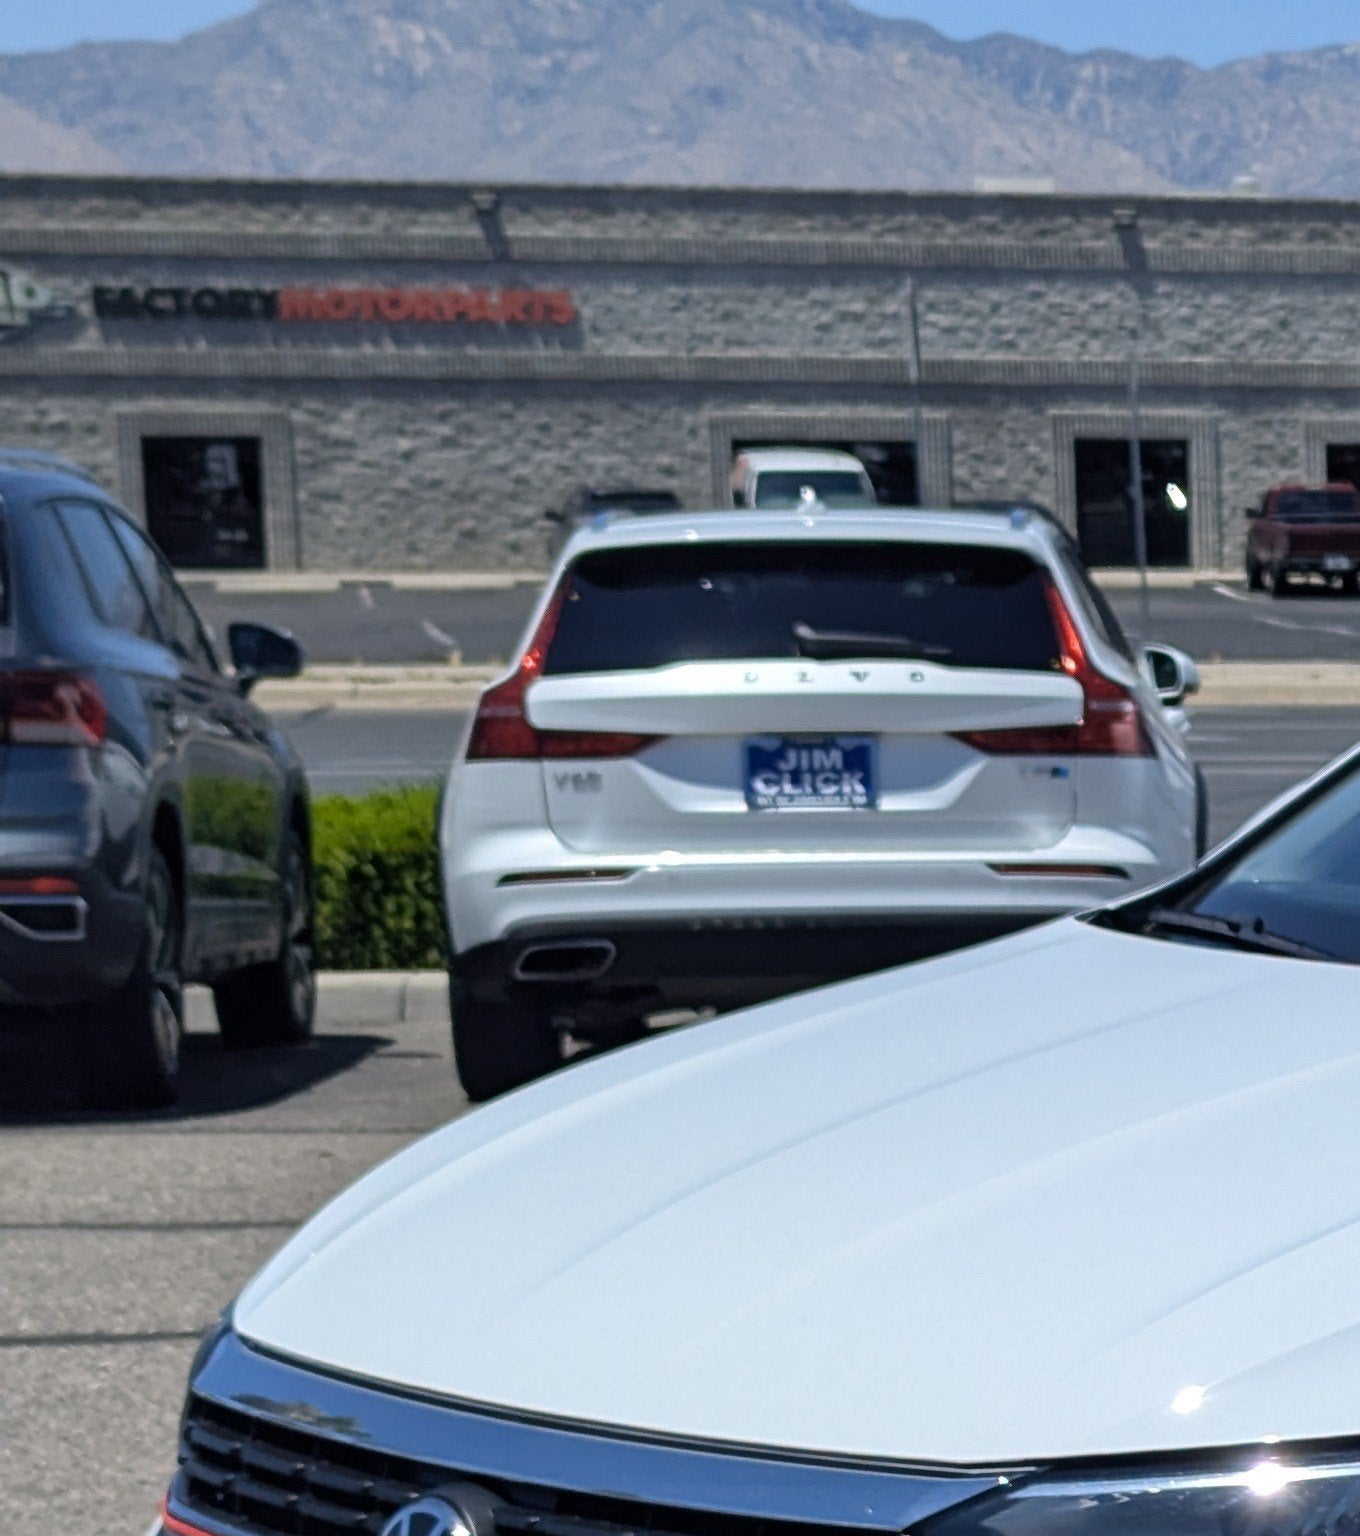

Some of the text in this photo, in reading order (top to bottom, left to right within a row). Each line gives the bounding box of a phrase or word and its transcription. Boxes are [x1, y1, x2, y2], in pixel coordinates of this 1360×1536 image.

[93, 288, 280, 320] FACTORY
[777, 747, 844, 771] JIM
[751, 771, 867, 795] CLICK
